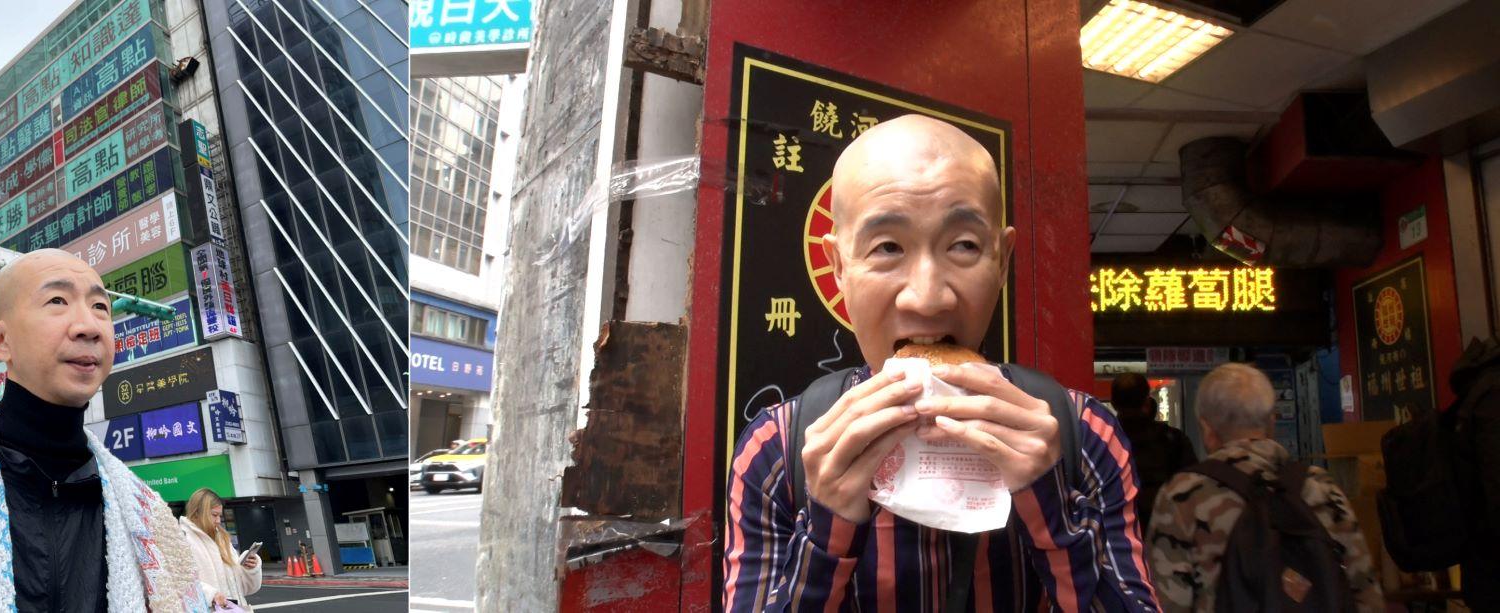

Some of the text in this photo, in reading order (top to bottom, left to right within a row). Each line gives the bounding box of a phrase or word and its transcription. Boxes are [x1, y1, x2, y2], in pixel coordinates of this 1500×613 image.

[94, 38, 148, 94] 高點
[70, 142, 119, 193] 高點
[30, 190, 112, 251] 志聖會計師
[138, 211, 161, 230] 醫學
[140, 225, 162, 244] 美容
[765, 133, 804, 337] 註 冊
[104, 260, 167, 297] 電腦
[125, 320, 159, 336] INSTITUTE
[410, 352, 444, 372] OTEL
[112, 427, 134, 450] 2F
[146, 421, 198, 441] 柳吟國文
[164, 477, 179, 485] Bank
